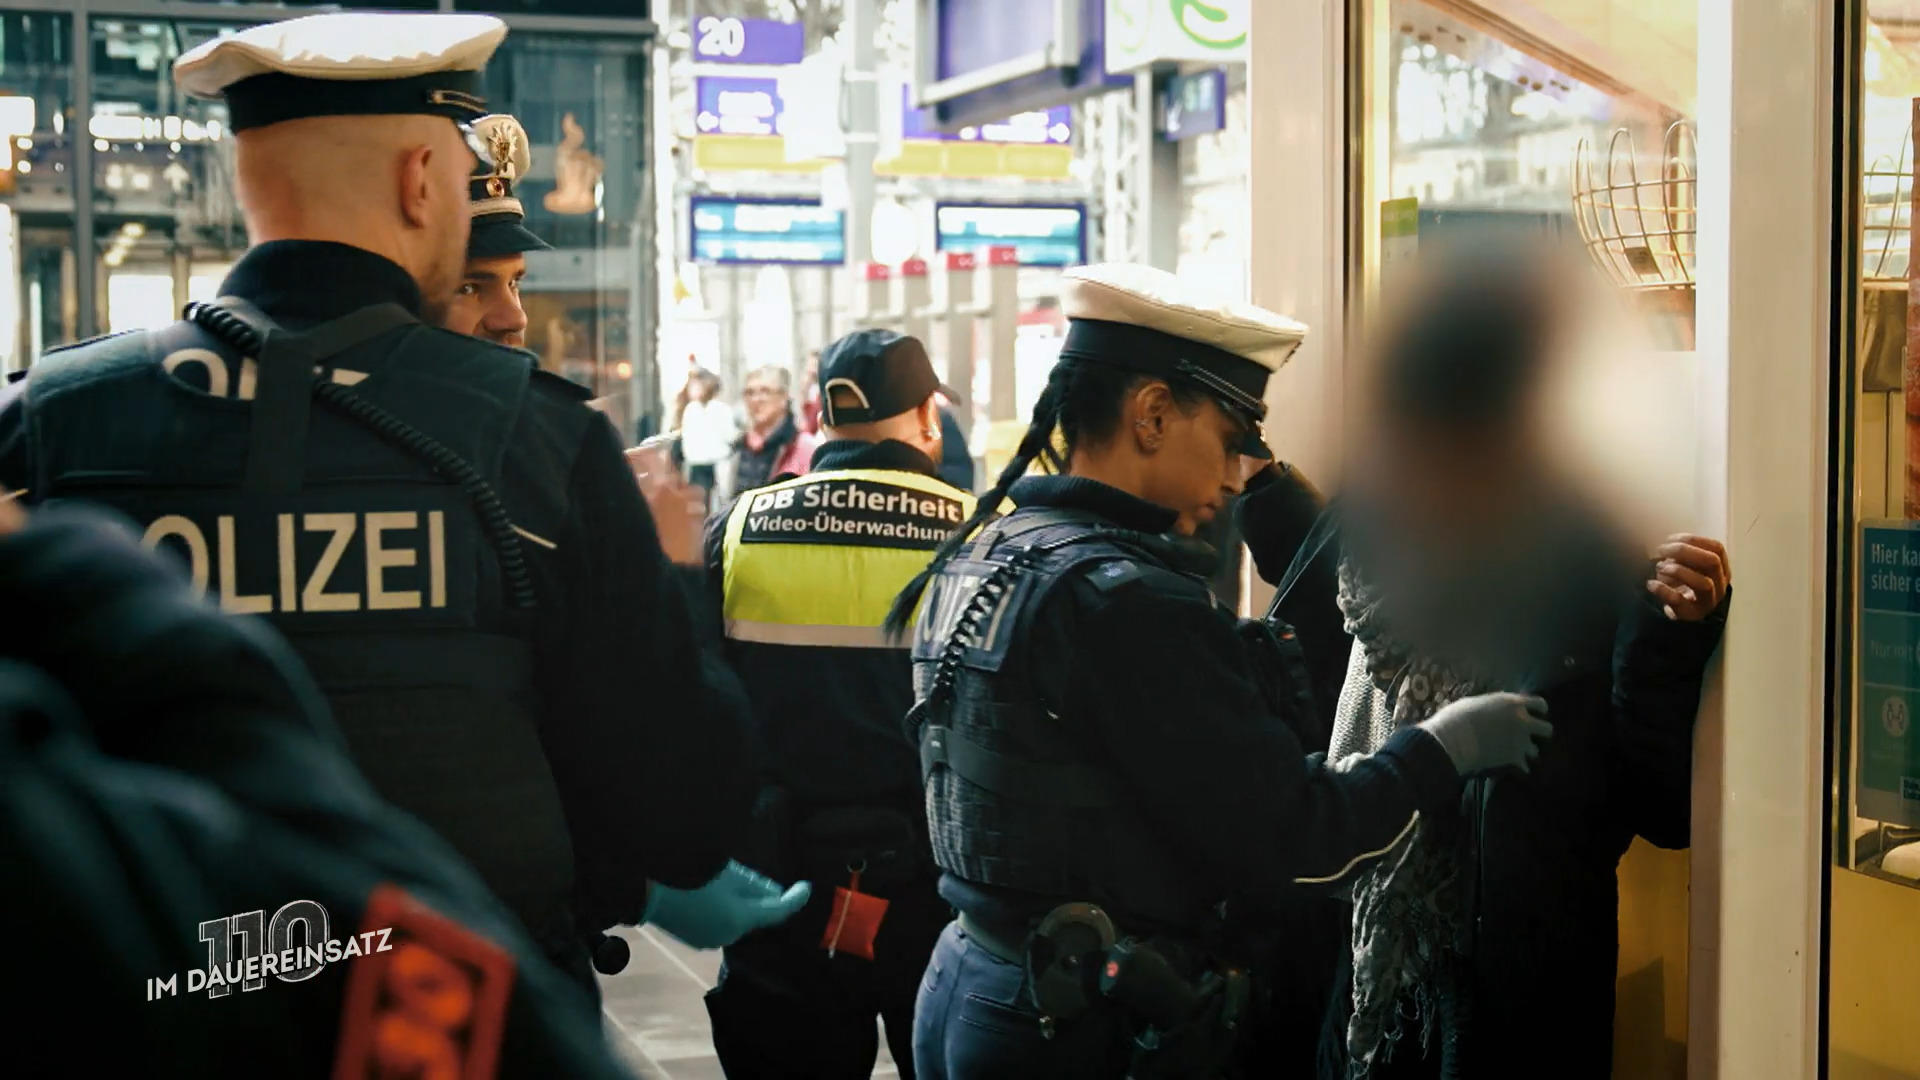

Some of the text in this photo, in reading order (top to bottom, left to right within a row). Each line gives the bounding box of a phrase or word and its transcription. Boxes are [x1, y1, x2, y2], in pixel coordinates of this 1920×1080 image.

[697, 16, 745, 56] 20
[751, 484, 961, 522] DB Sicherheit
[141, 510, 448, 613] OLIZEI
[1871, 543, 1899, 565] Hier
[1871, 569, 1911, 593] sicher
